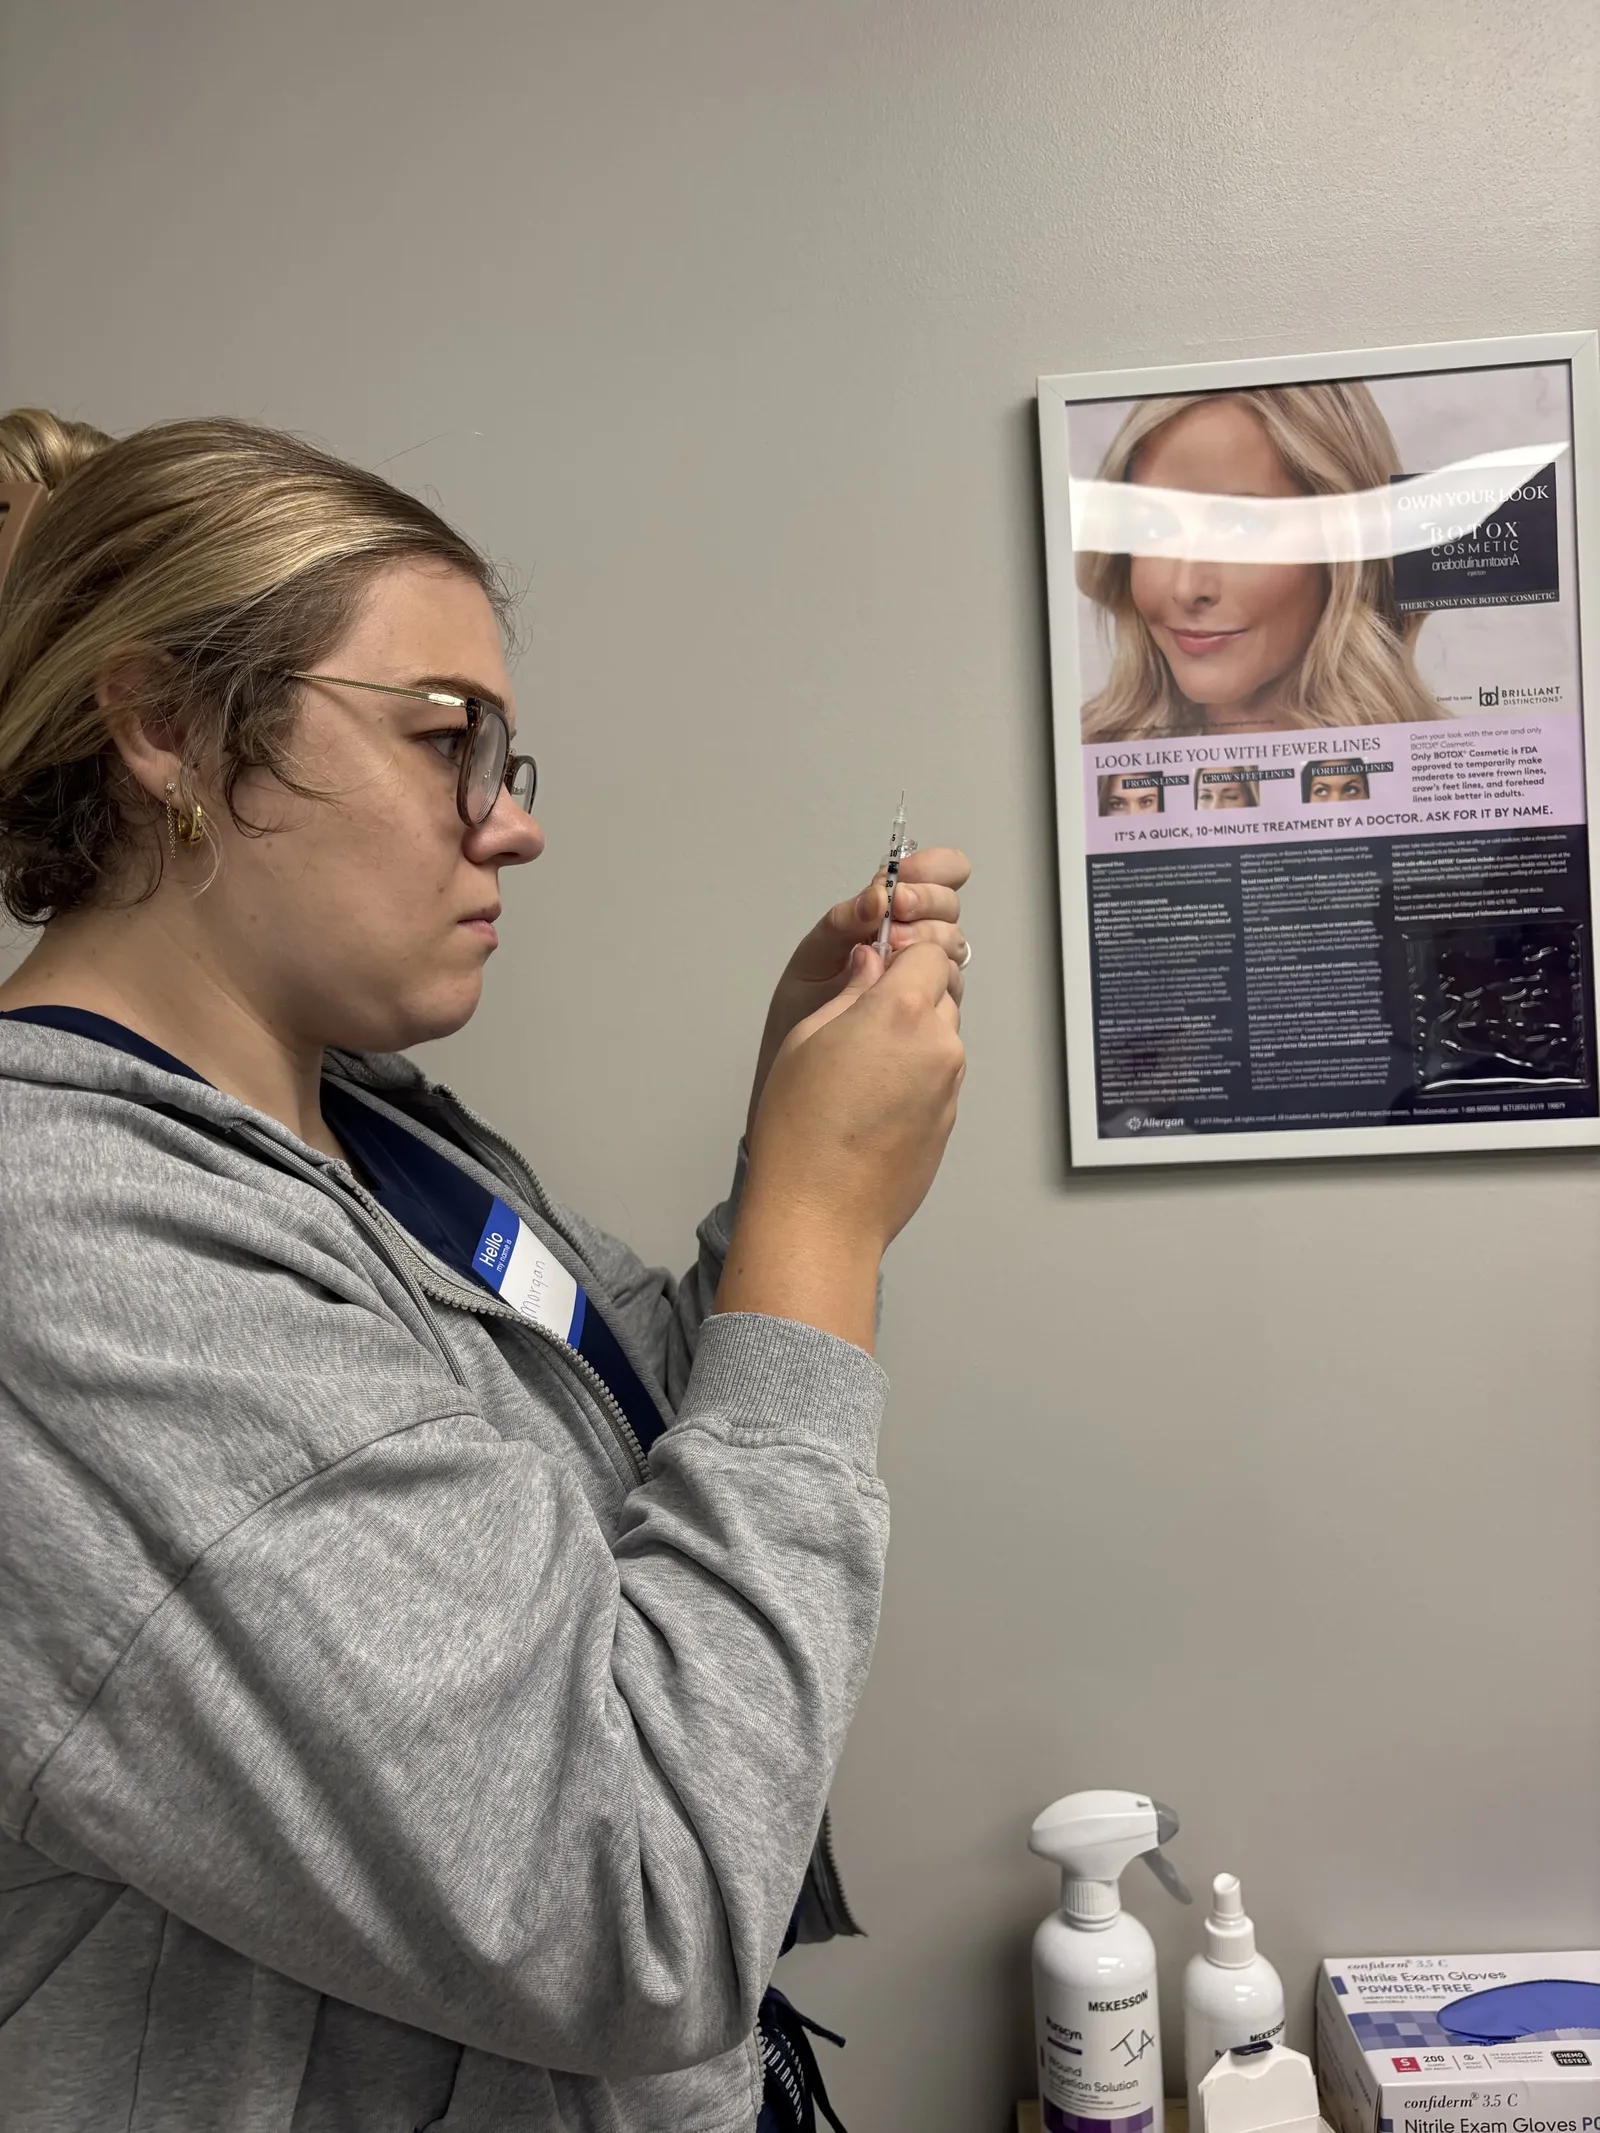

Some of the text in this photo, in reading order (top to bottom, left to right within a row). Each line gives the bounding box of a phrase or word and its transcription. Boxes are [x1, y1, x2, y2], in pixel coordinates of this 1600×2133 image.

[1398, 485, 1549, 510] OWN YOUR LOOK
[1429, 521, 1519, 543] BOTOX
[1431, 540, 1519, 556] COSMETIC
[1432, 553, 1520, 572] onabotulinumtoxinA
[1400, 600, 1435, 611] THERE'S
[1436, 598, 1458, 608] ONLY
[1510, 592, 1555, 602] COSMETIC
[1502, 686, 1561, 698] BRILLIANT
[1410, 733, 1427, 741] Own
[1429, 733, 1445, 741] your
[1527, 726, 1542, 734] only
[1095, 737, 1381, 769] LOOK LIKE YOU WITH FEWER LINES
[1411, 752, 1431, 761] Only
[1469, 748, 1509, 758] Cosmetic
[1511, 747, 1518, 755] is
[1520, 746, 1538, 755] FDA
[1311, 763, 1392, 776] FOREHEAD LINES
[1412, 762, 1451, 772] approved
[1466, 759, 1516, 769] temporarily
[1518, 757, 1542, 765] make
[1126, 776, 1186, 788] FROWN LINES
[1265, 770, 1293, 779] LINES
[1412, 773, 1454, 782] moderate
[1468, 770, 1494, 778] severe
[1524, 767, 1546, 776] lines,
[1412, 777, 1545, 792] crow's feet lines, and forehead
[1412, 789, 1525, 803] lines look better in adults.
[1114, 805, 1553, 842] IT'S A QUICK, 10-MINUTE TREATMENT BY A DOCTOR. ASK FOR IT BY NAME.
[886, 880, 893, 888] 20
[1142, 1117, 1184, 1129] Allergan
[479, 1232, 503, 1267] Hello
[500, 1245, 510, 1262] name
[496, 1262, 505, 1272] my
[520, 1260, 548, 1319] Morgan
[1416, 1959, 1434, 1968] 3.5
[1438, 1959, 1449, 1967] C
[1352, 1970, 1507, 1983] Nitrile Exam Gloves
[1358, 1984, 1474, 1994] POWDER-FREE
[1088, 1990, 1148, 2012] McKESSON
[1400, 2058, 1411, 2066] S
[1422, 2055, 1445, 2063] 200
[1094, 2079, 1139, 2092] Solution
[1482, 2094, 1501, 2108] 3.5
[1507, 2093, 1518, 2107] C
[1405, 2118, 1454, 2133] Nitrile
[1460, 2118, 1507, 2133] Exam
[1512, 2117, 1576, 2132] Gloves
